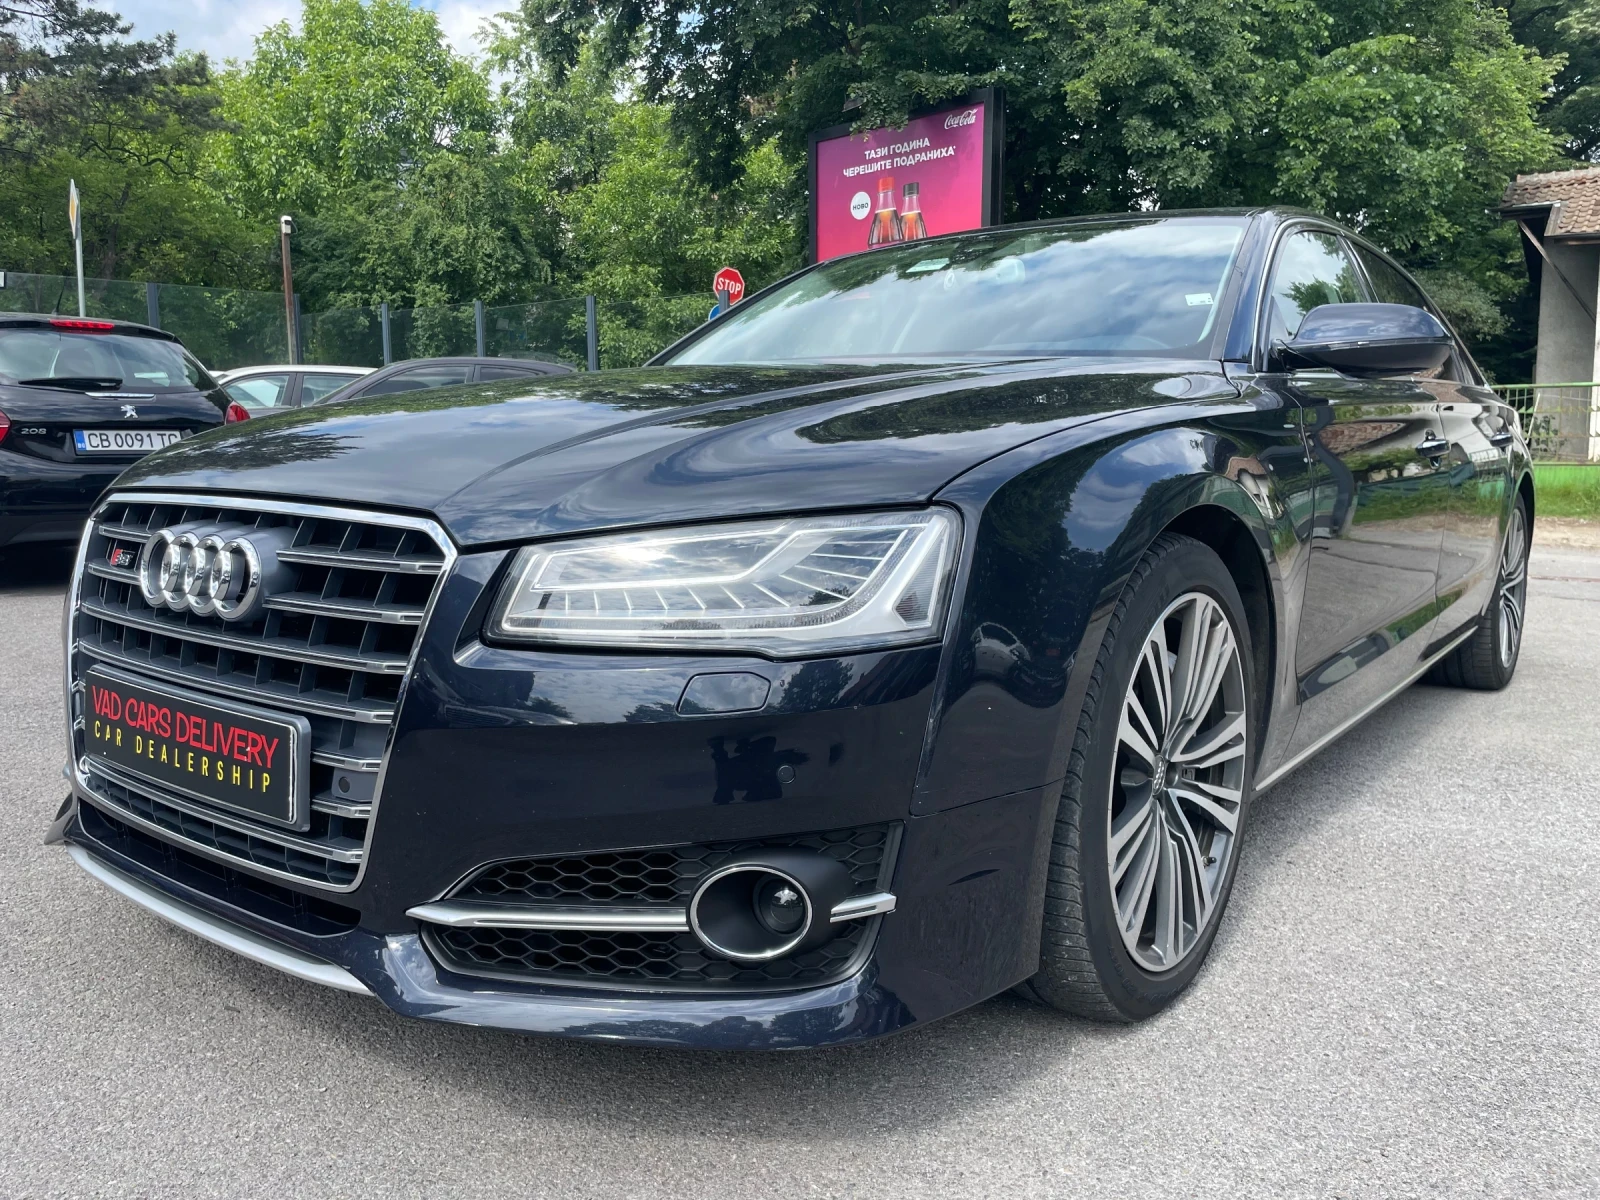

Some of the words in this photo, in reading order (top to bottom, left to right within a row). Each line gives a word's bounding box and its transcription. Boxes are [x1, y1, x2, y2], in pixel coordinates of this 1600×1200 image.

[864, 146, 888, 160] ТАЗИ
[890, 137, 930, 154] ГОДИНА
[843, 159, 892, 178] ЧЕРЕШИТЕ
[852, 202, 869, 210] НОВО
[717, 277, 742, 295] STOP
[88, 433, 111, 448] CB
[114, 433, 153, 448] 0091
[92, 685, 122, 721] VAD
[125, 698, 171, 738] CARS
[176, 711, 280, 769] DELIVERY
[94, 720, 122, 747] CAR
[136, 735, 271, 793] DEALERSHIP
